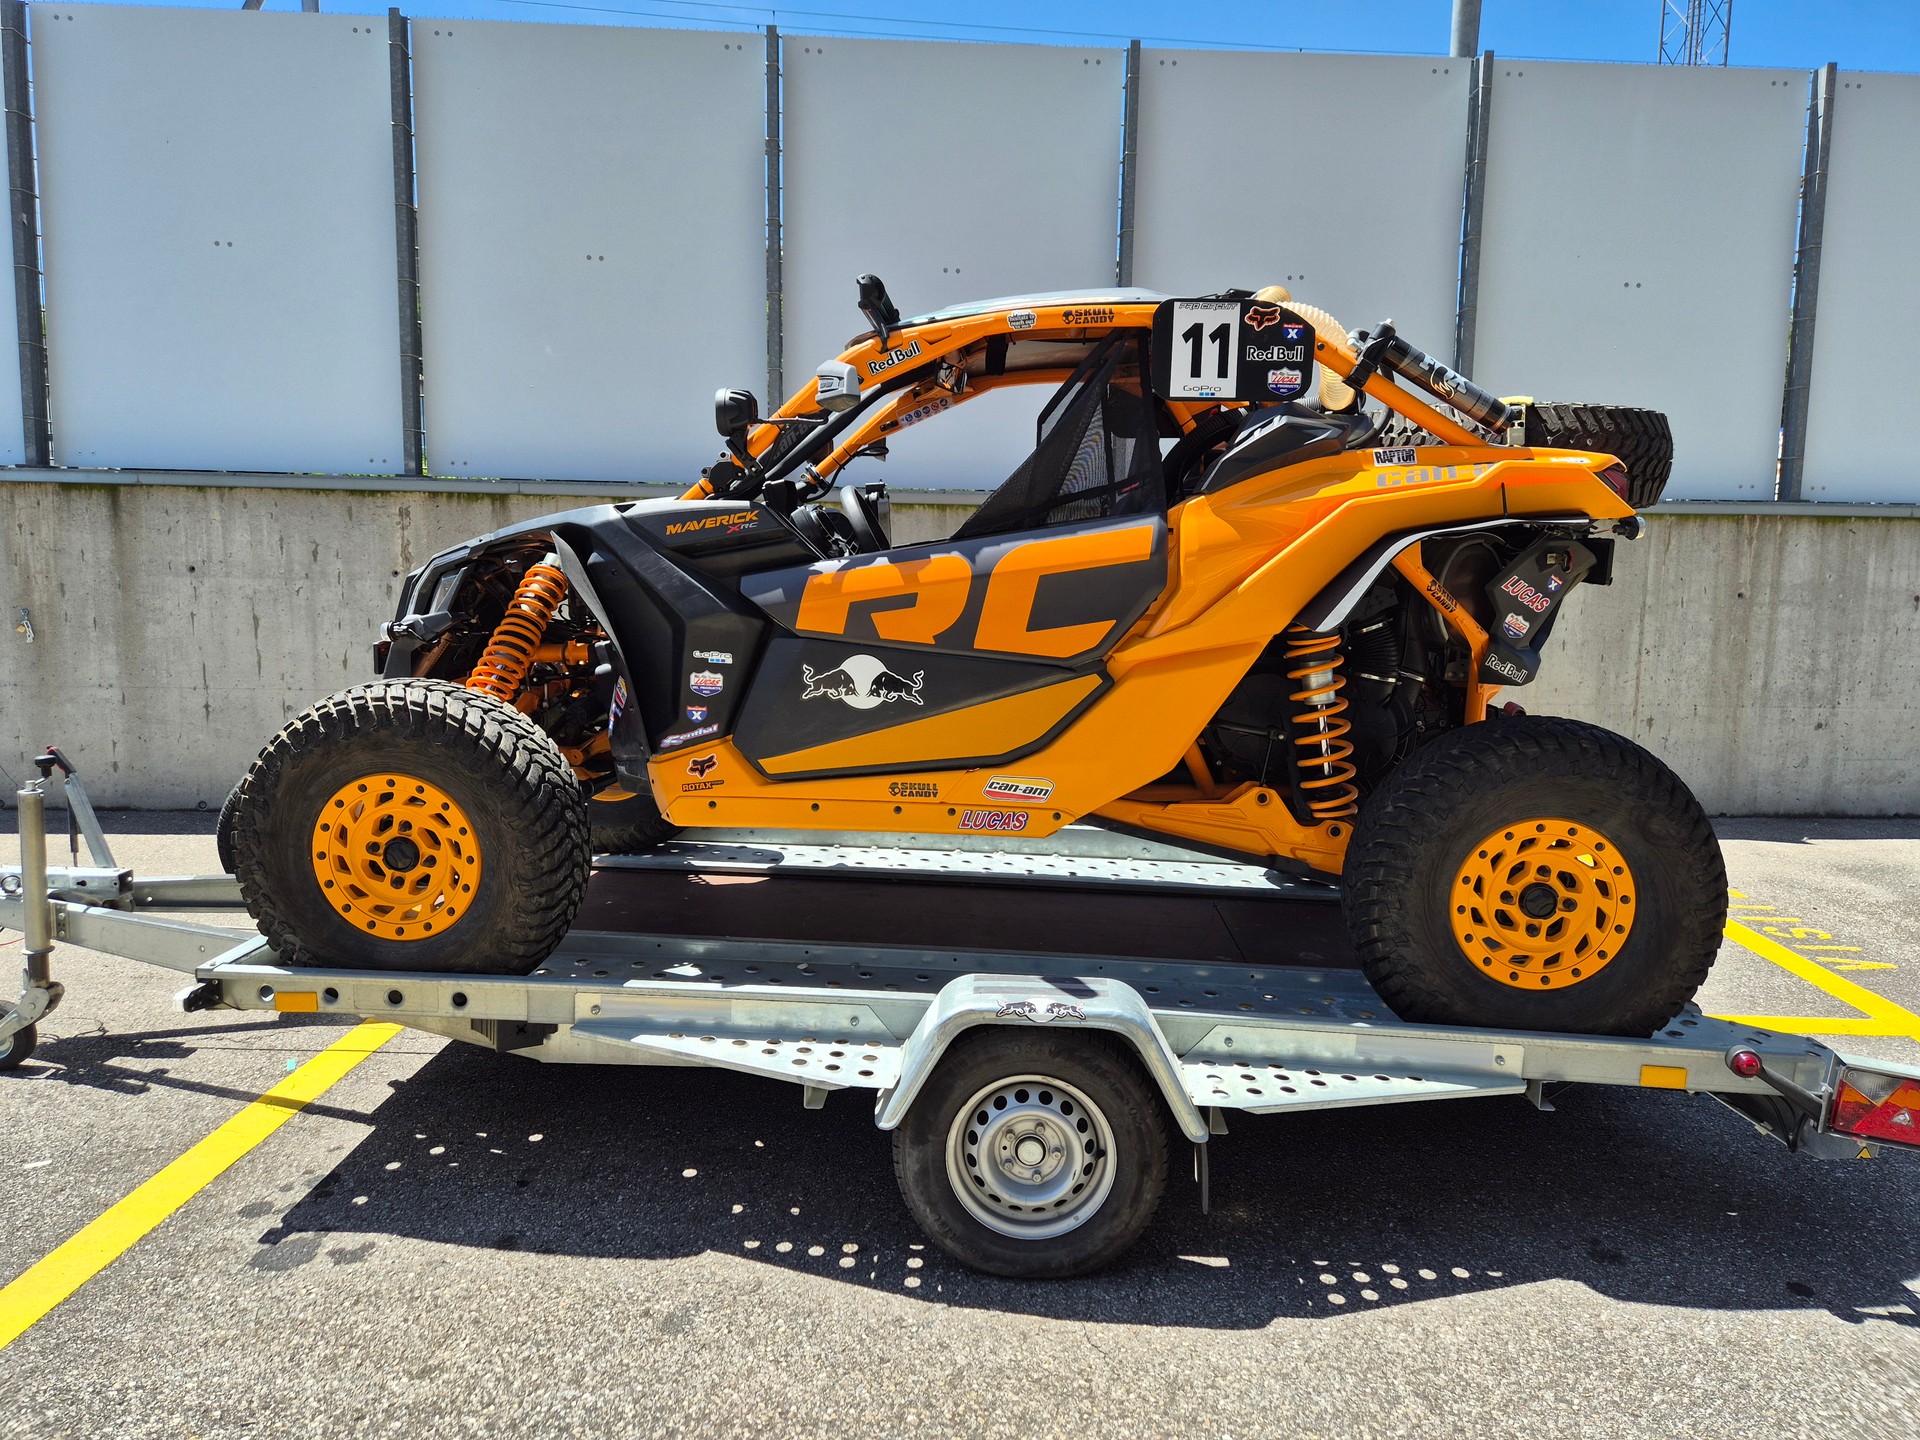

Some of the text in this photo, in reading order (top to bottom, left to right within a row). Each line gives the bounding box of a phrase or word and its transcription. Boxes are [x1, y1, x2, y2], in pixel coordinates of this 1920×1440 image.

[1074, 308, 1115, 316] SKULL
[1074, 316, 1115, 324] CANDY
[1286, 328, 1299, 339] X
[1181, 322, 1231, 379] 11
[1374, 448, 1416, 464] RAPTOR
[1376, 464, 1496, 488] can-a
[666, 510, 760, 536] MAVERICK
[726, 522, 759, 535] XRC
[795, 525, 1154, 658] RC
[1435, 584, 1458, 608] SKULL
[1501, 575, 1551, 613] LUCAS
[1430, 590, 1457, 614] CANDY
[693, 650, 732, 659] GoPro
[692, 711, 702, 720] X
[682, 782, 713, 792] ROTAX
[900, 782, 939, 791] SKULL
[900, 790, 939, 798] CANDY
[988, 781, 1050, 797] can-am
[958, 809, 1029, 832] LUCAS
